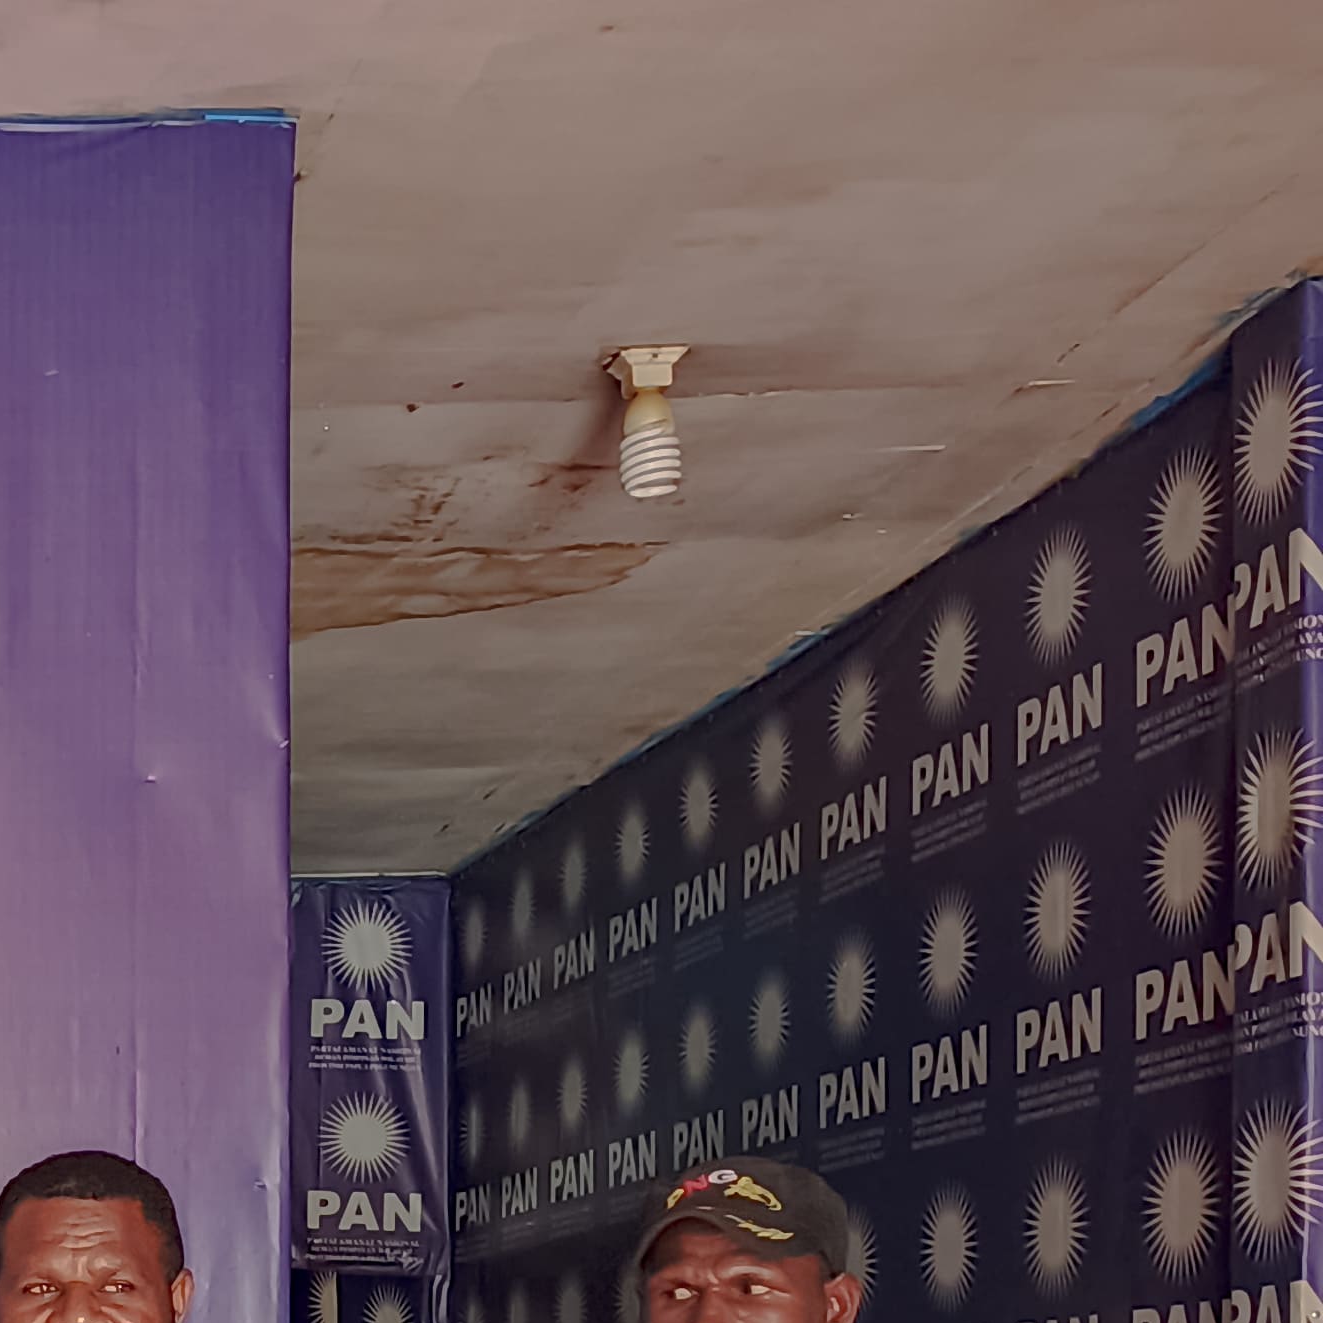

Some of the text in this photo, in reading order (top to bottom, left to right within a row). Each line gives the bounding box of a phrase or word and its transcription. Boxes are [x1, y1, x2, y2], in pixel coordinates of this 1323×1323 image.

[1136, 594, 1235, 707] PAN
[1017, 663, 1103, 766] PAN
[912, 722, 989, 816] PAN
[820, 776, 887, 860] PAN
[744, 822, 800, 899] PAN
[674, 862, 726, 932] PAN
[554, 929, 595, 990] PAN
[608, 898, 658, 963] PAN
[310, 999, 425, 1040] PAN
[456, 984, 492, 1038] PAN
[504, 959, 541, 1015] PAN
[1135, 944, 1235, 1040] PAN
[1015, 987, 1102, 1074] PAN
[819, 1057, 886, 1129] PAN
[912, 1025, 988, 1104] PAN
[673, 1109, 724, 1171] PAN
[742, 1085, 799, 1151] PAN
[550, 1149, 594, 1203] PAN
[608, 1131, 656, 1185] PAN
[307, 1190, 422, 1232] PAN
[456, 1185, 491, 1232] PAN
[502, 1168, 538, 1218] PAN
